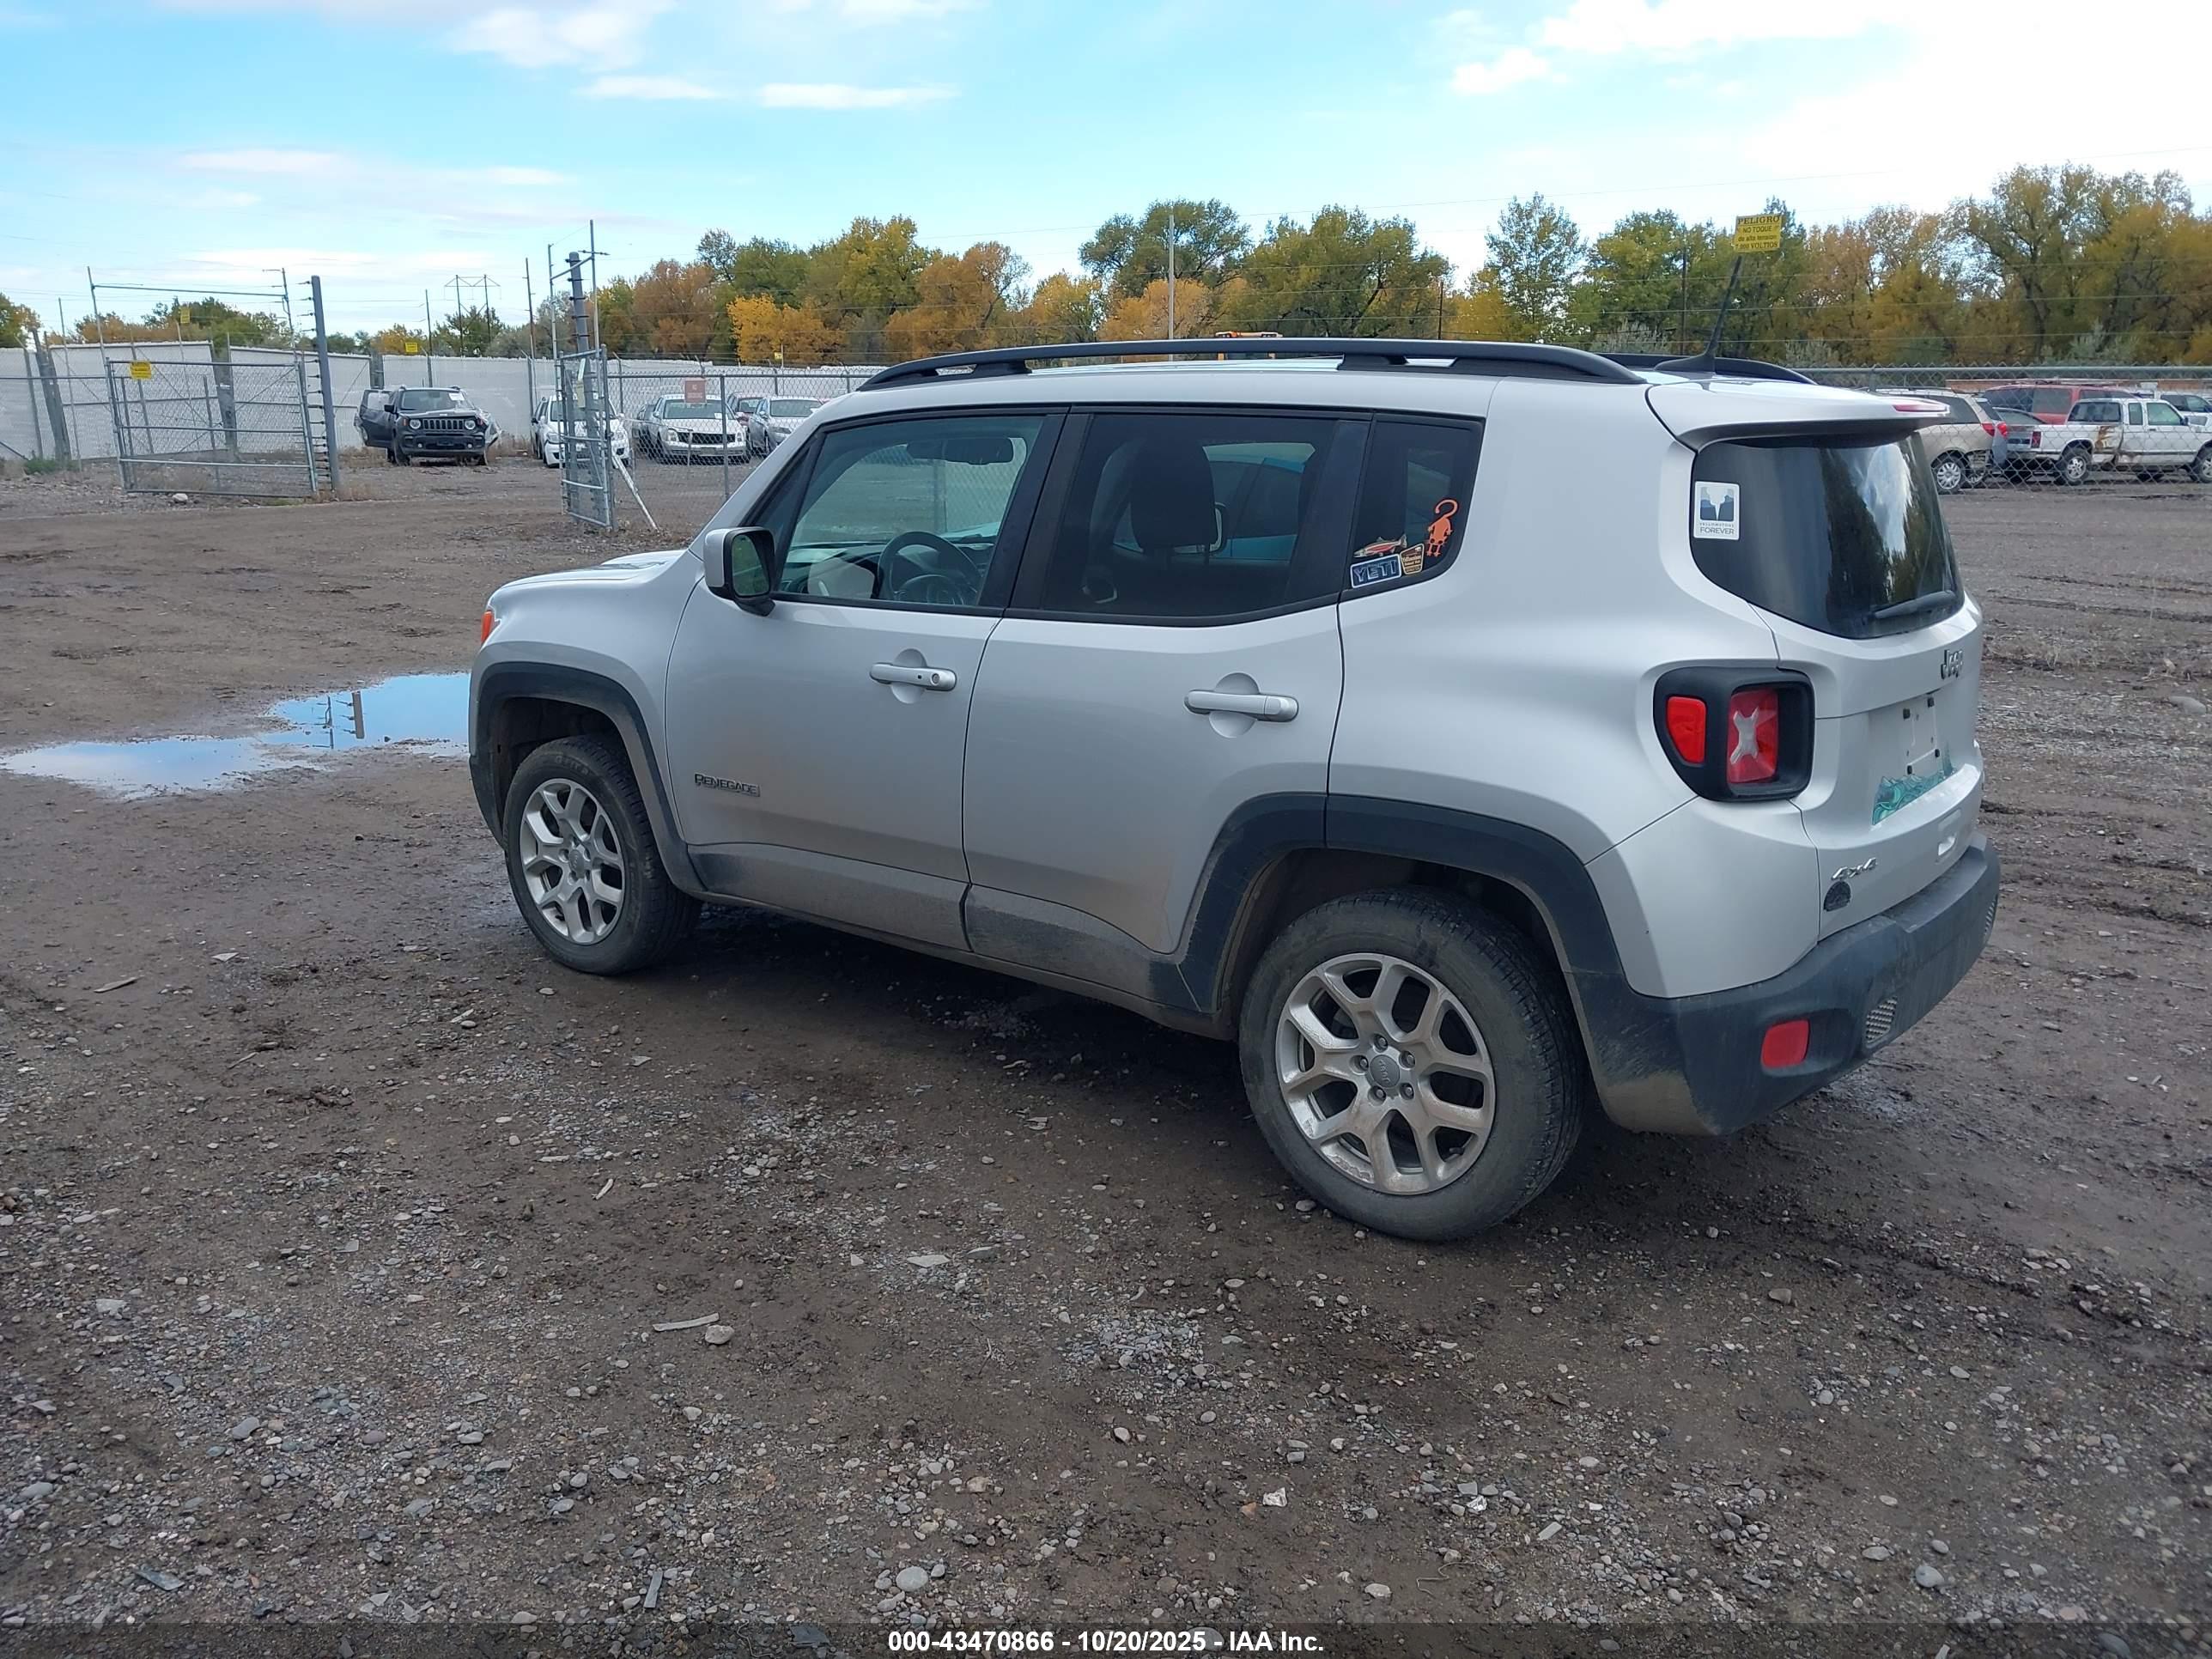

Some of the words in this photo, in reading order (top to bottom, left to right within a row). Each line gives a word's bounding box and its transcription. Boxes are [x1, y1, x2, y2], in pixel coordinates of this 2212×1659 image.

[1738, 216, 1780, 225] PELIGRO
[1700, 526, 1735, 535] FOREVER
[1353, 560, 1397, 582] YETI
[1941, 649, 1963, 679] Jeep
[694, 773, 761, 797] RENEGADE
[1831, 857, 1878, 881] 4x4
